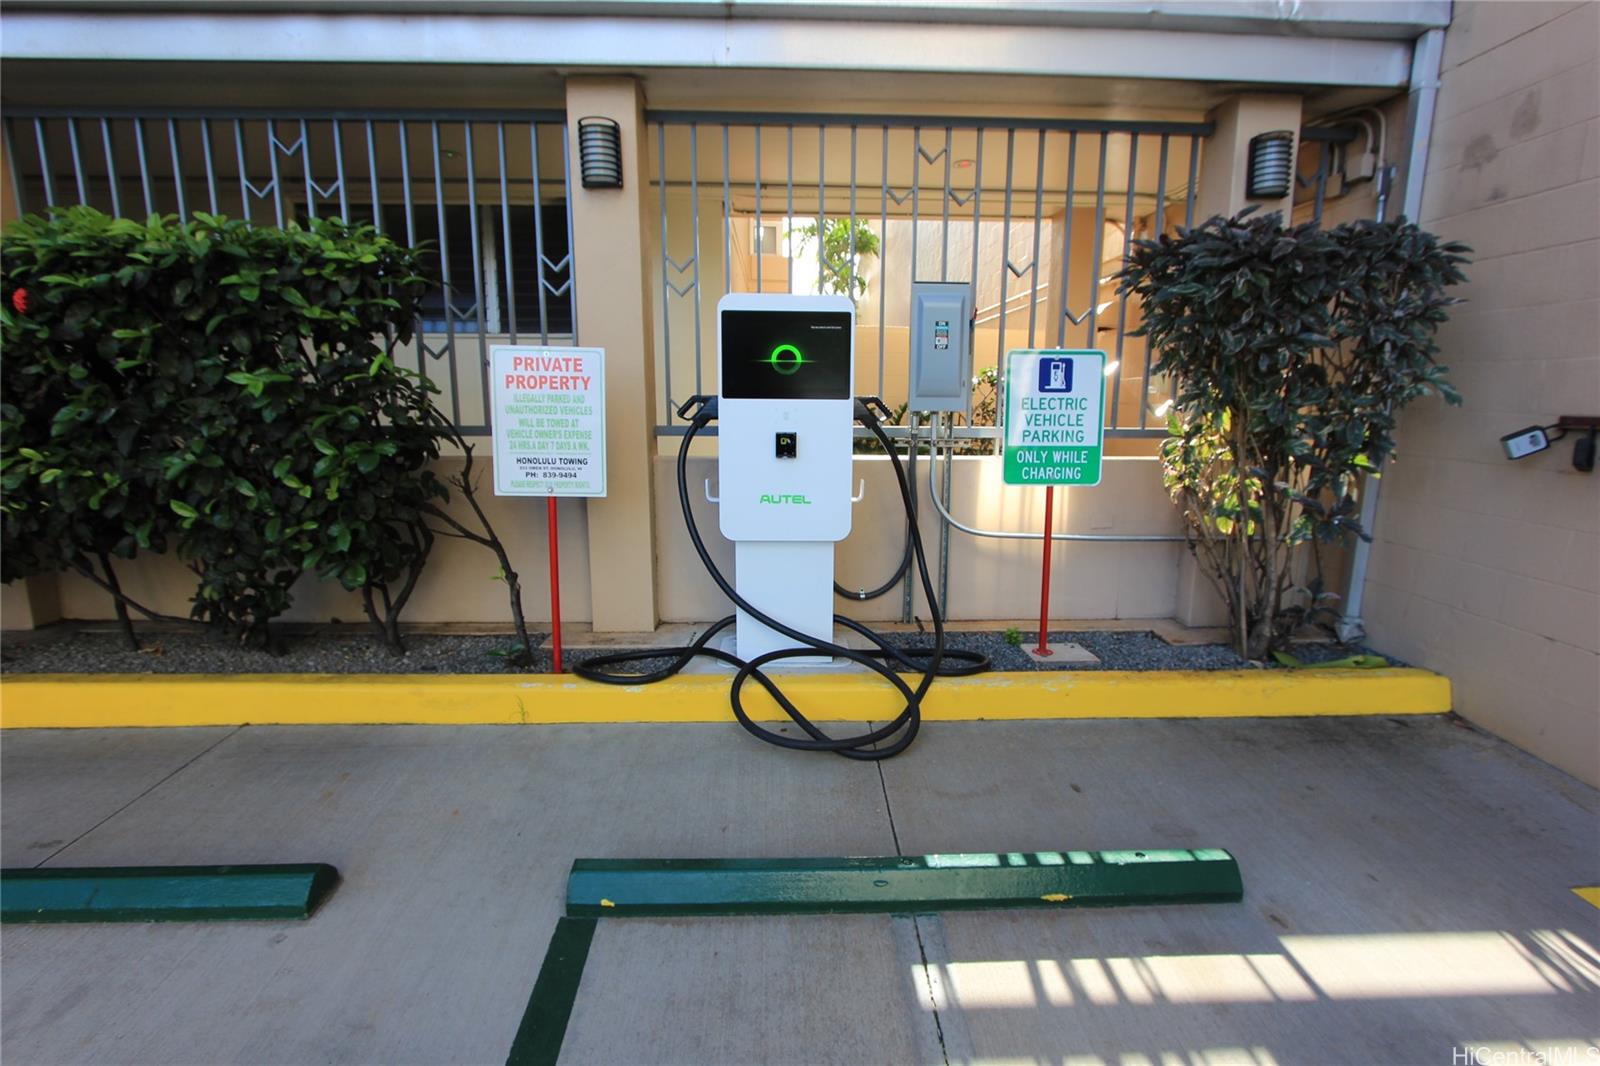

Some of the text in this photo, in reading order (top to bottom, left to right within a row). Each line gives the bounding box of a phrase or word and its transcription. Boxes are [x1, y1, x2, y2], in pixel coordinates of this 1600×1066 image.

[513, 357, 583, 372] PRIVATE
[505, 375, 591, 390] PROPERTY
[513, 394, 585, 404] ILLEGALLY PARKED AND
[1021, 398, 1087, 410] ELECTRIC
[505, 405, 593, 415] UNAUTHORIZED VEHICLES
[519, 418, 579, 428] WILL BE TOWED AT
[1025, 414, 1084, 426] VEHICLE
[507, 429, 592, 440] VEHICLE OWNER'S EXPENSE
[1022, 430, 1085, 442] PARKING
[509, 440, 517, 450] 24
[537, 441, 549, 450] DAY
[549, 441, 554, 450] 7
[555, 441, 571, 450] DAYS
[572, 441, 576, 450] A
[516, 457, 557, 465] HONOLULU
[1017, 451, 1088, 464] ONLY WHILE
[525, 471, 539, 479] PH:
[1022, 467, 1081, 479] CHARGING
[759, 494, 811, 504] AUTEL
